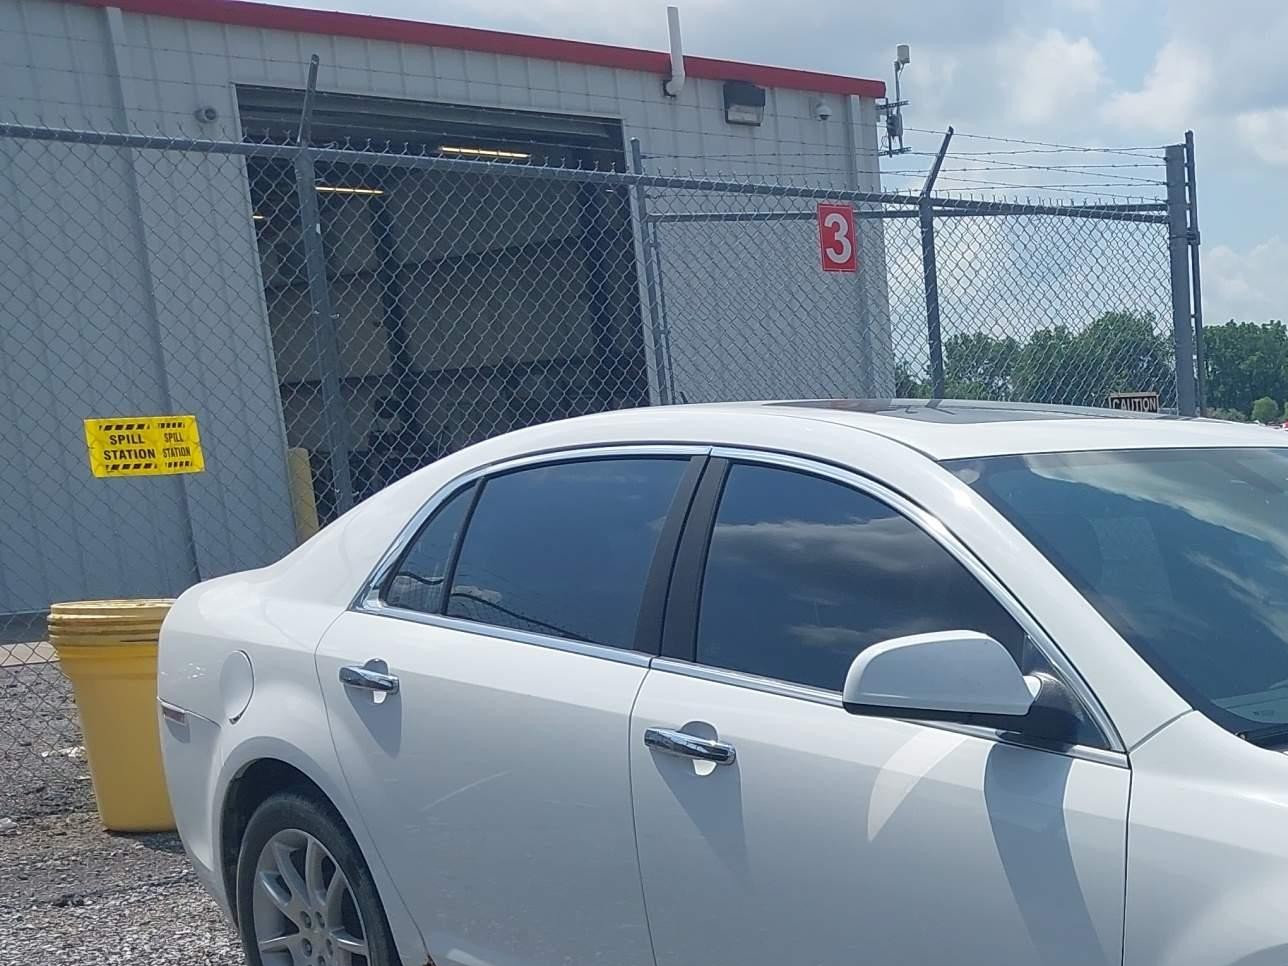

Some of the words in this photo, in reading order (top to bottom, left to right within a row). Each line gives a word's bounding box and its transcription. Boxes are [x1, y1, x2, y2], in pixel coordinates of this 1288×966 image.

[824, 213, 852, 264] 3
[1112, 397, 1157, 412] CAUTION
[109, 433, 145, 446] SPILL
[164, 432, 184, 443] SPILL
[103, 448, 156, 461] STATION
[162, 446, 191, 458] STATION
